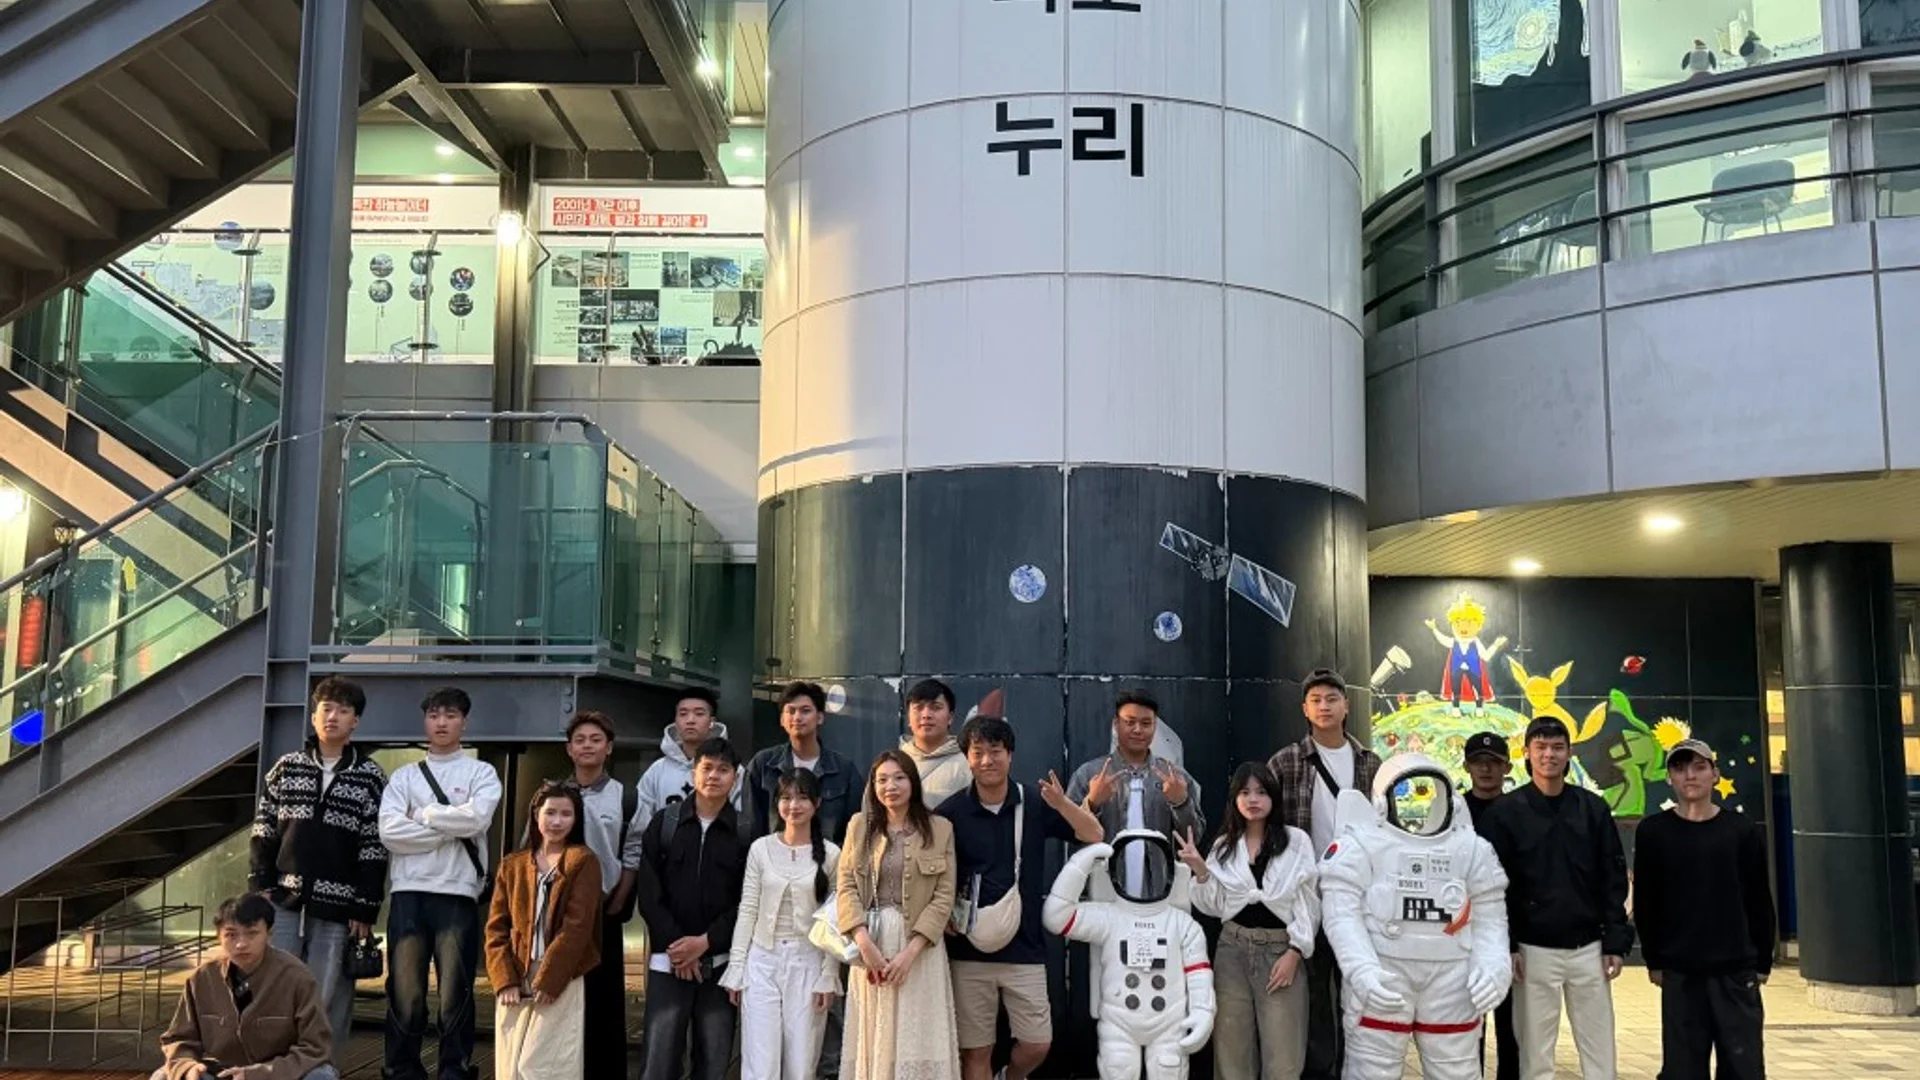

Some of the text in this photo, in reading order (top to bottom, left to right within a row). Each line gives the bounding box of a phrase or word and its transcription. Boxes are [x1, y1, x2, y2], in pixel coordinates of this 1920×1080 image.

[987, 101, 1144, 177] 누리
[555, 198, 591, 211] 2001년
[616, 200, 638, 212] 이후
